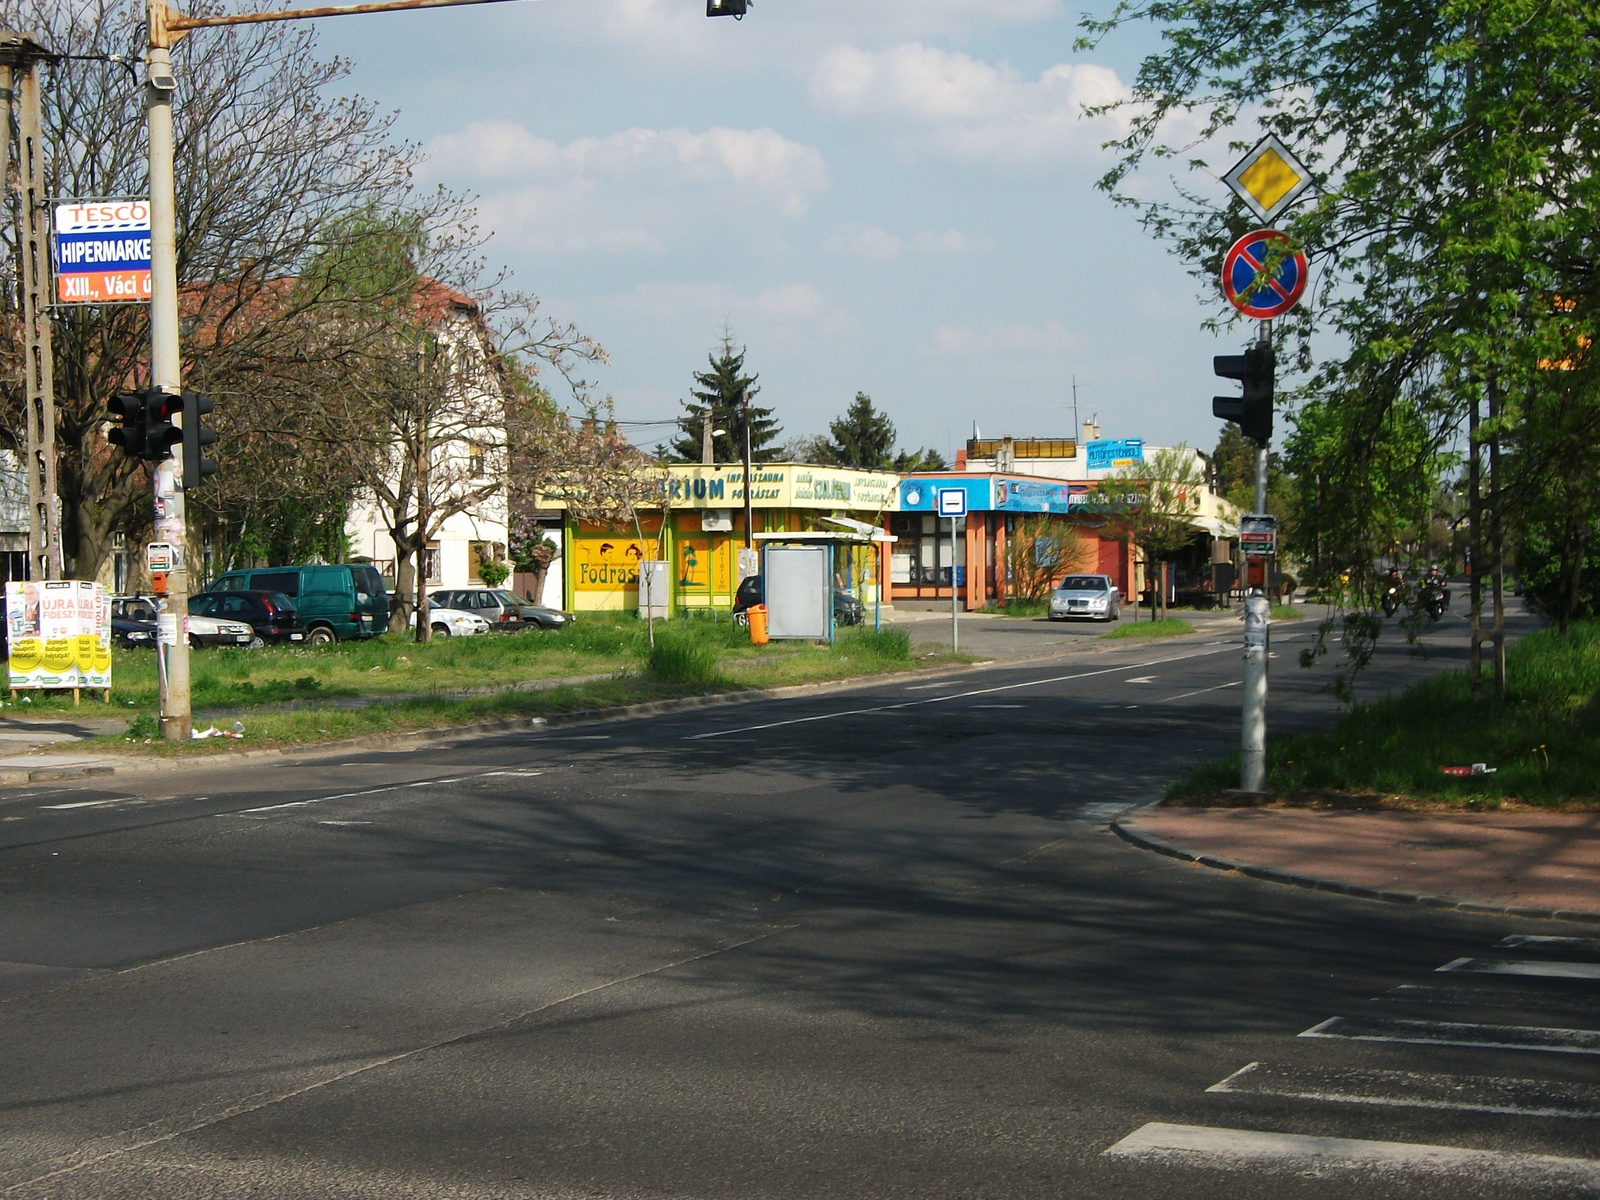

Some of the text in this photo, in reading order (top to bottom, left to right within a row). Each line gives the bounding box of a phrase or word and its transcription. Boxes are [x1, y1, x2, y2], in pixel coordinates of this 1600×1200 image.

[68, 206, 147, 222] TESCO
[61, 239, 151, 264] HIPERMARKE
[65, 274, 151, 298] XIII., Váci ú
[732, 486, 781, 500] FORÁSZAT
[580, 562, 640, 584] Fodrás
[43, 596, 75, 609] ÚJRA
[43, 611, 76, 619] FIDESZ!
